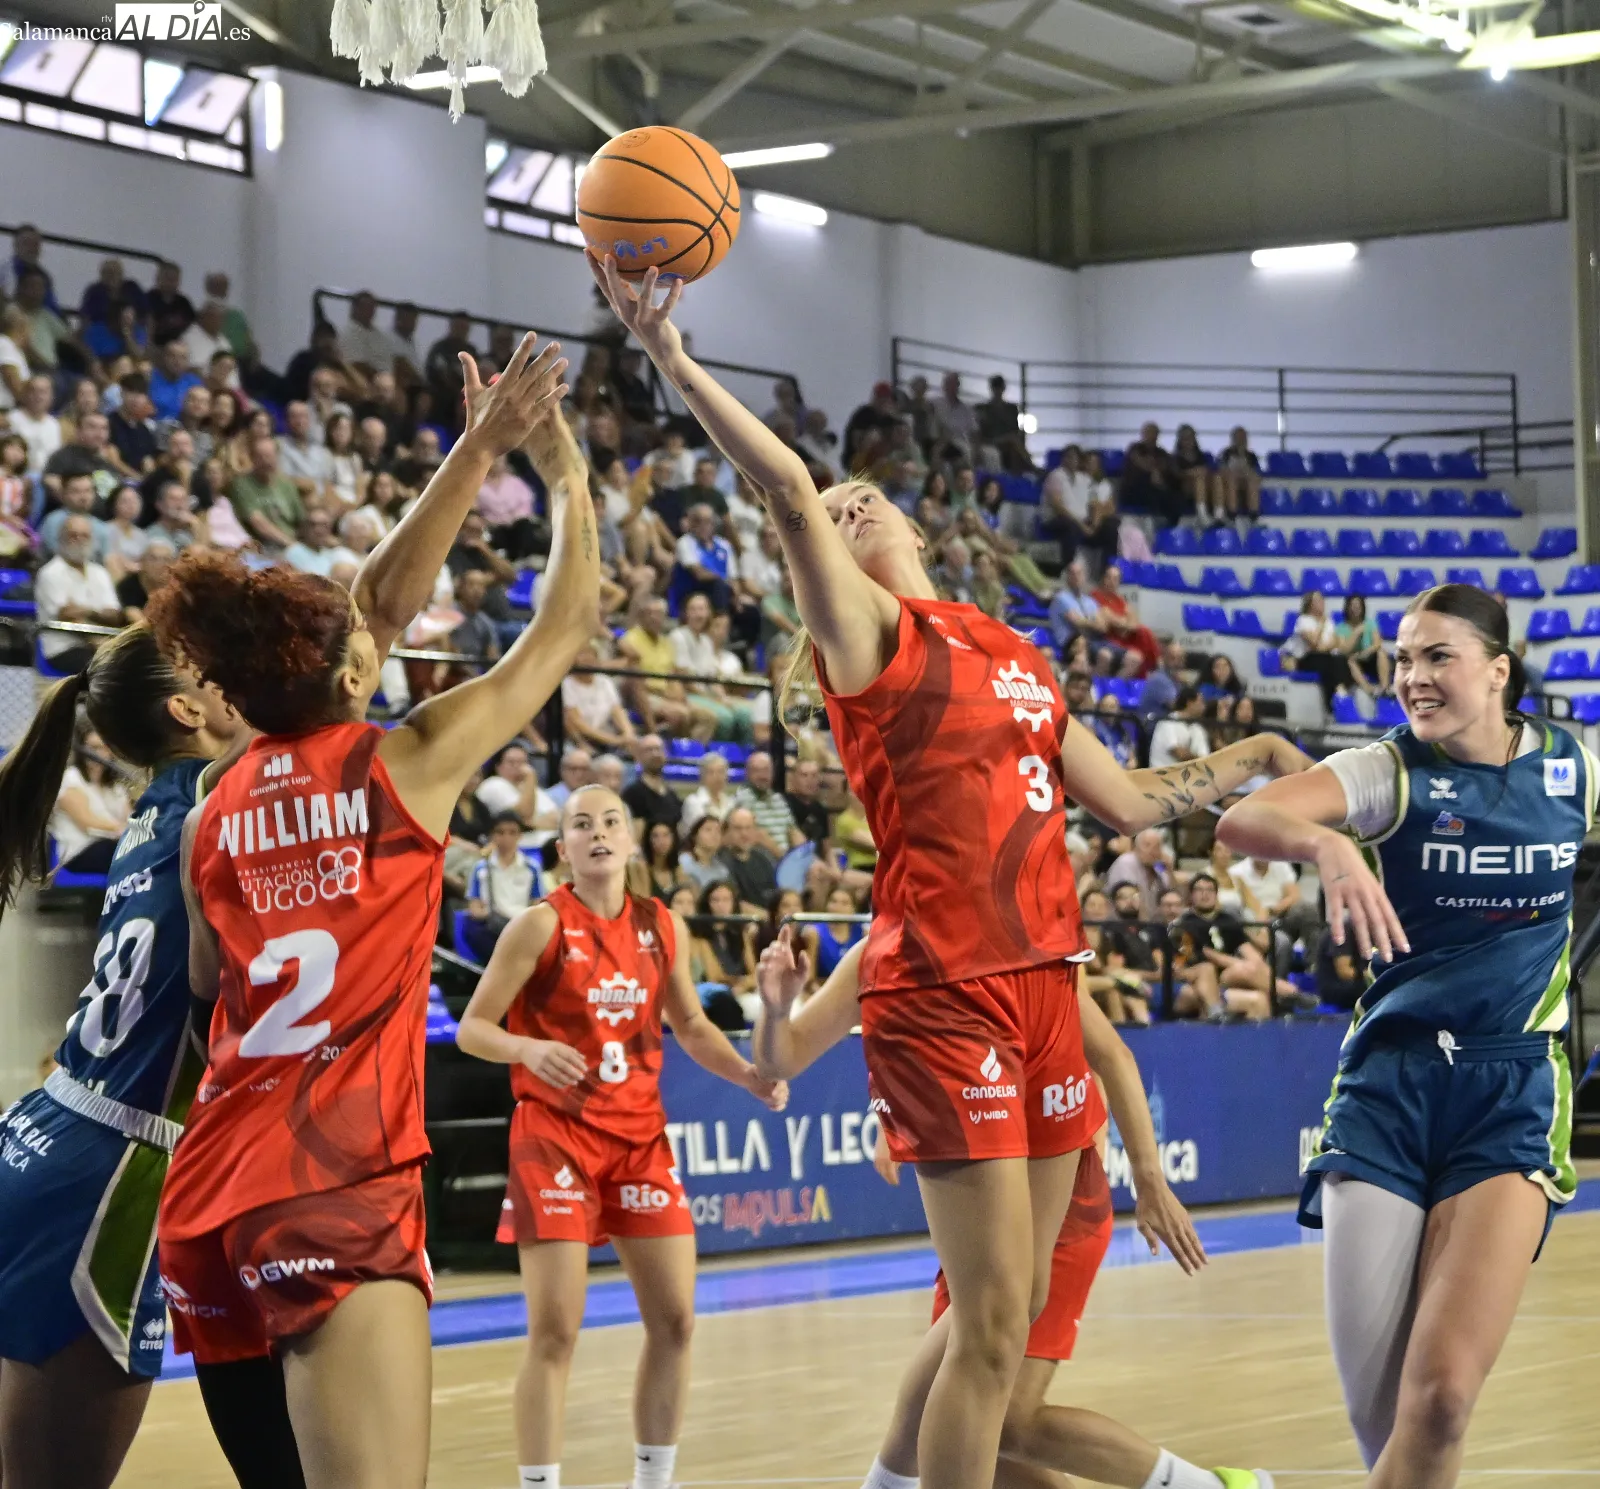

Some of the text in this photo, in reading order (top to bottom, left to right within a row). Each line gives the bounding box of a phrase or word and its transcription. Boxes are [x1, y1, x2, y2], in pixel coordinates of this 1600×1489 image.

[1018, 754, 1053, 813] 3
[217, 787, 370, 858] WILLIAM
[239, 866, 314, 894] UTACIÓN
[250, 880, 317, 915] UGO
[1435, 890, 1566, 909] CASTILLA Y LEÓN
[238, 928, 340, 1058] 2
[598, 1041, 629, 1083] 8
[962, 1084, 1017, 1100] CANDELAS
[984, 1110, 1009, 1120] WIBO
[663, 1118, 771, 1176] TILLA
[785, 1114, 811, 1181] Y
[688, 1194, 722, 1226] OS
[260, 1257, 336, 1283] GWM
